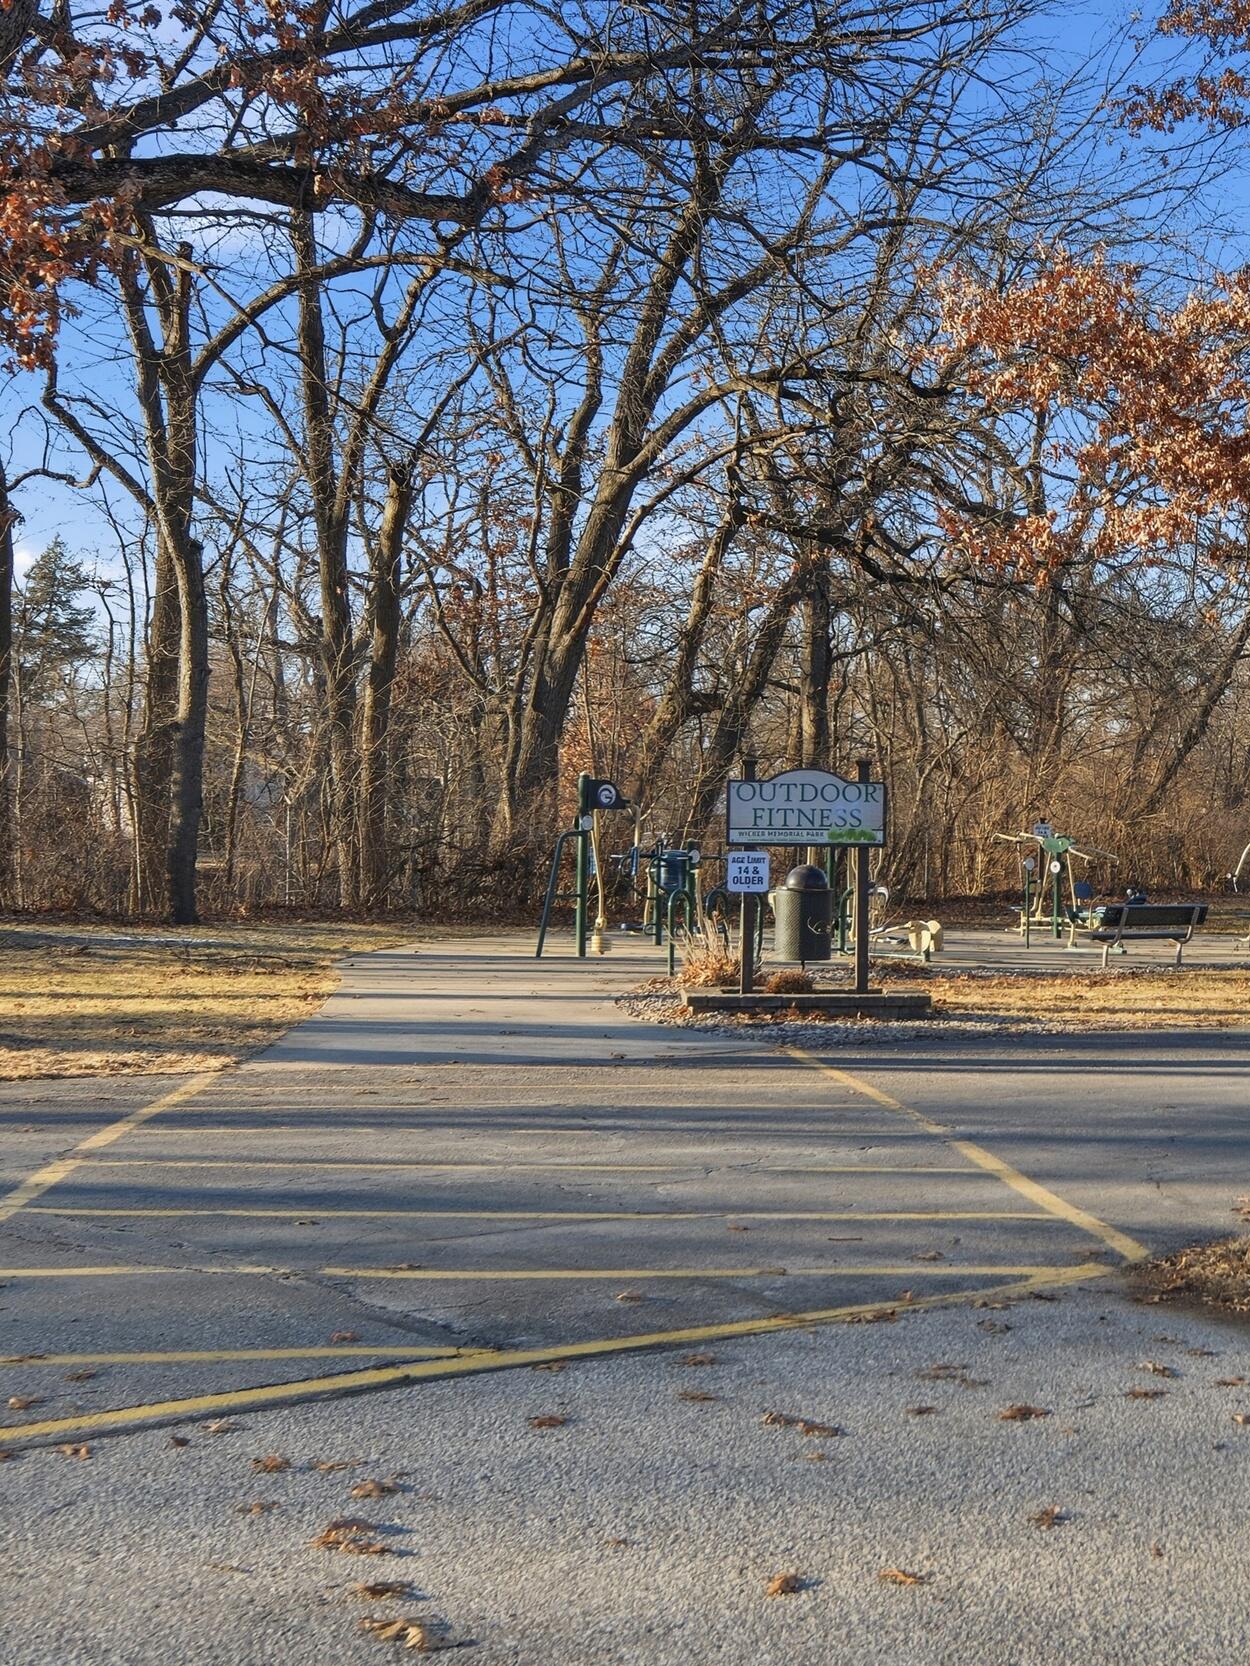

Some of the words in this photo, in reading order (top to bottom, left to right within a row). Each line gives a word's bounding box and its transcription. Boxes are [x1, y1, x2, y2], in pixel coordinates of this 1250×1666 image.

[736, 782, 880, 803] OUTDOOR
[752, 807, 863, 828] FITNESS
[731, 856, 746, 864] AGE
[738, 866, 749, 875] 14
[752, 866, 760, 875] &
[732, 876, 764, 885] OLDER
